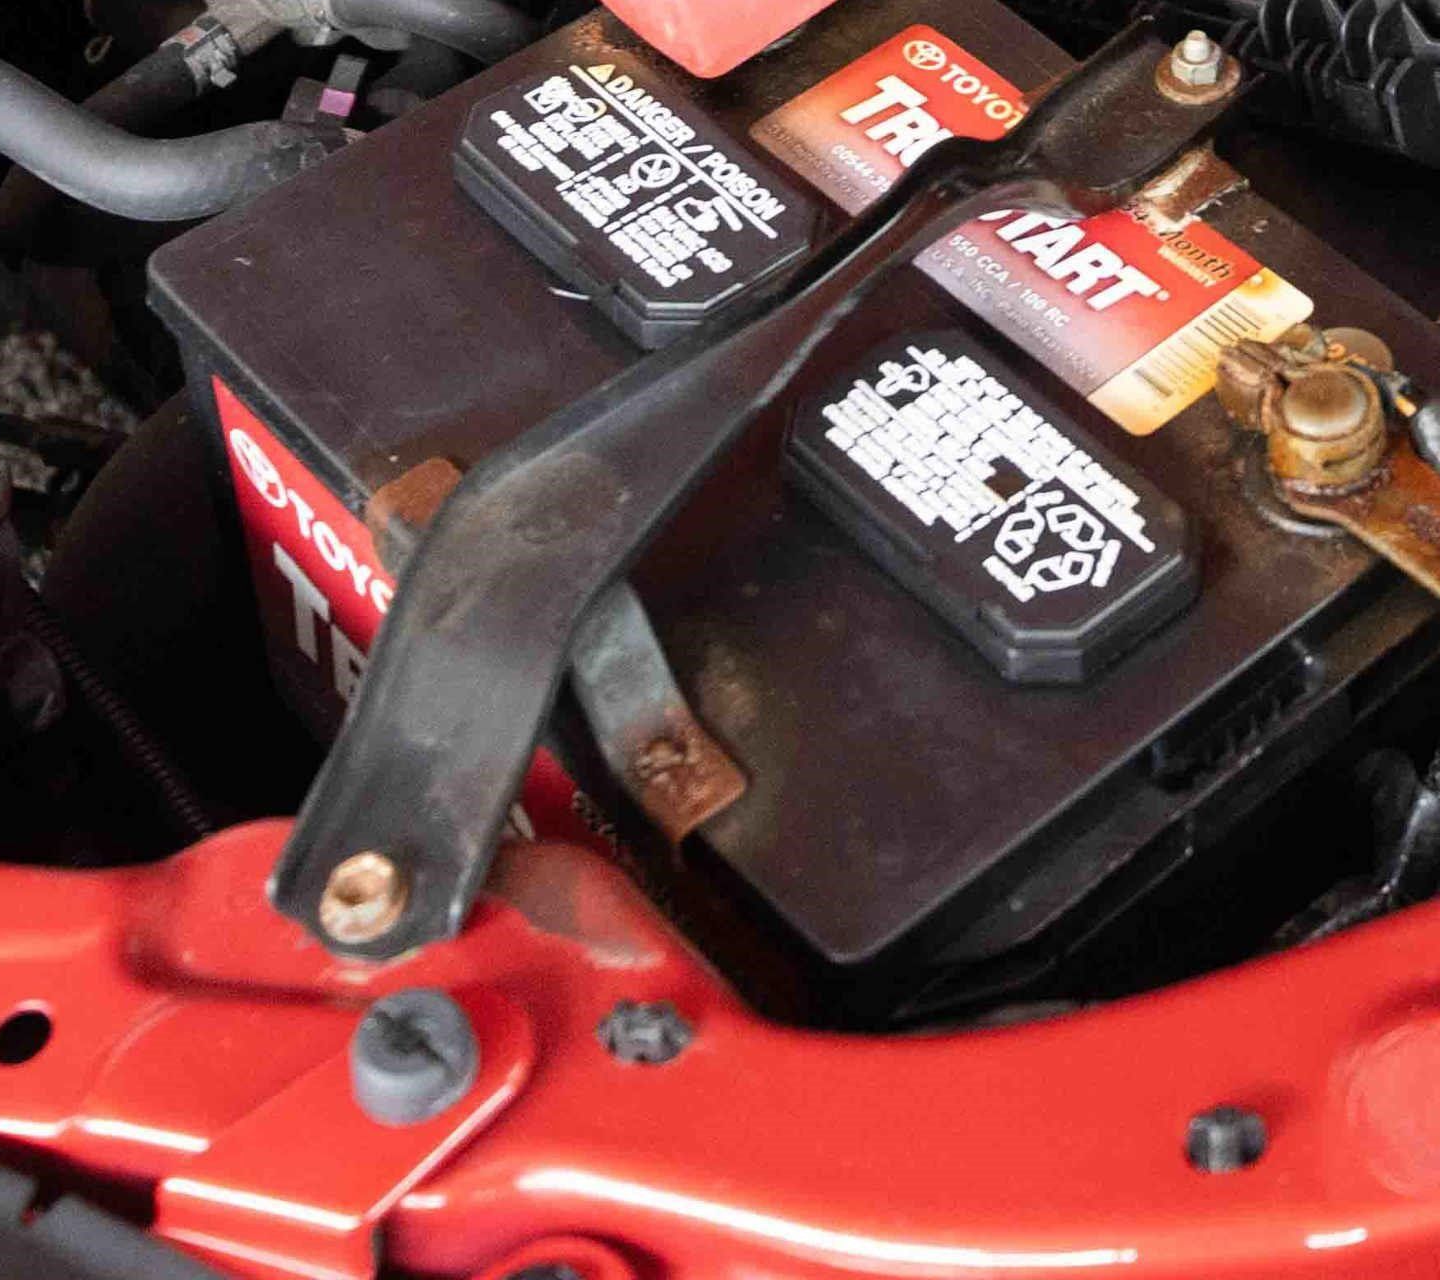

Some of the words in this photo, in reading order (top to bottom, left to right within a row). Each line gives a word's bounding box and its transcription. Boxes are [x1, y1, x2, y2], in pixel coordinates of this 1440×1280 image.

[604, 74, 696, 147] DANGER
[697, 151, 786, 221] POISON
[948, 235, 978, 258] 550
[976, 254, 1011, 284] CCA
[1019, 288, 1048, 312] 100
[1042, 304, 1072, 328] RC
[977, 208, 1161, 312] TART
